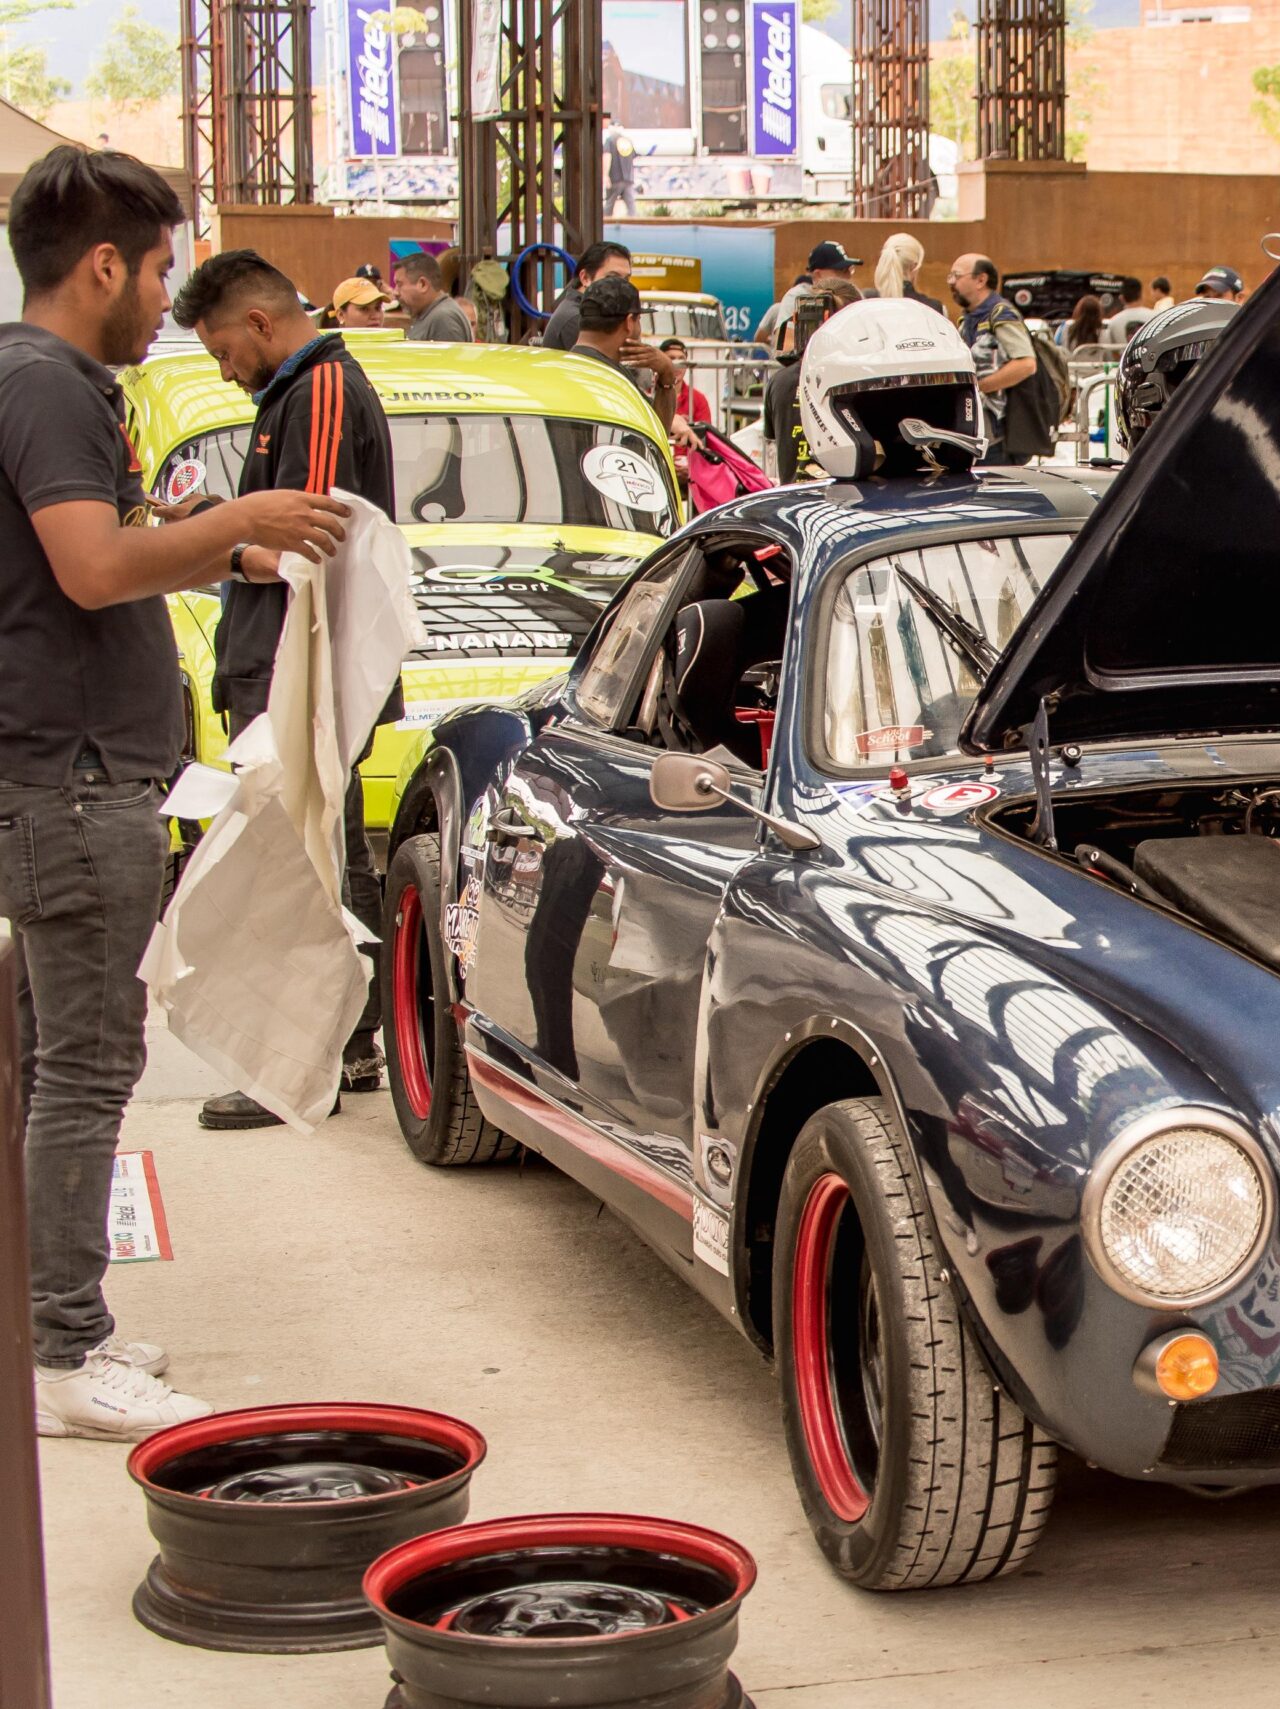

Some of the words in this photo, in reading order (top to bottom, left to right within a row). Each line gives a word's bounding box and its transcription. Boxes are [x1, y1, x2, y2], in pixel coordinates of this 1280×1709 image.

[356, 8, 389, 110] telcel
[761, 11, 792, 111] telcel
[895, 341, 936, 351] sparco
[614, 458, 638, 475] 21
[867, 733, 911, 746] School
[944, 786, 982, 801] E
[91, 1397, 118, 1412] Reebok
